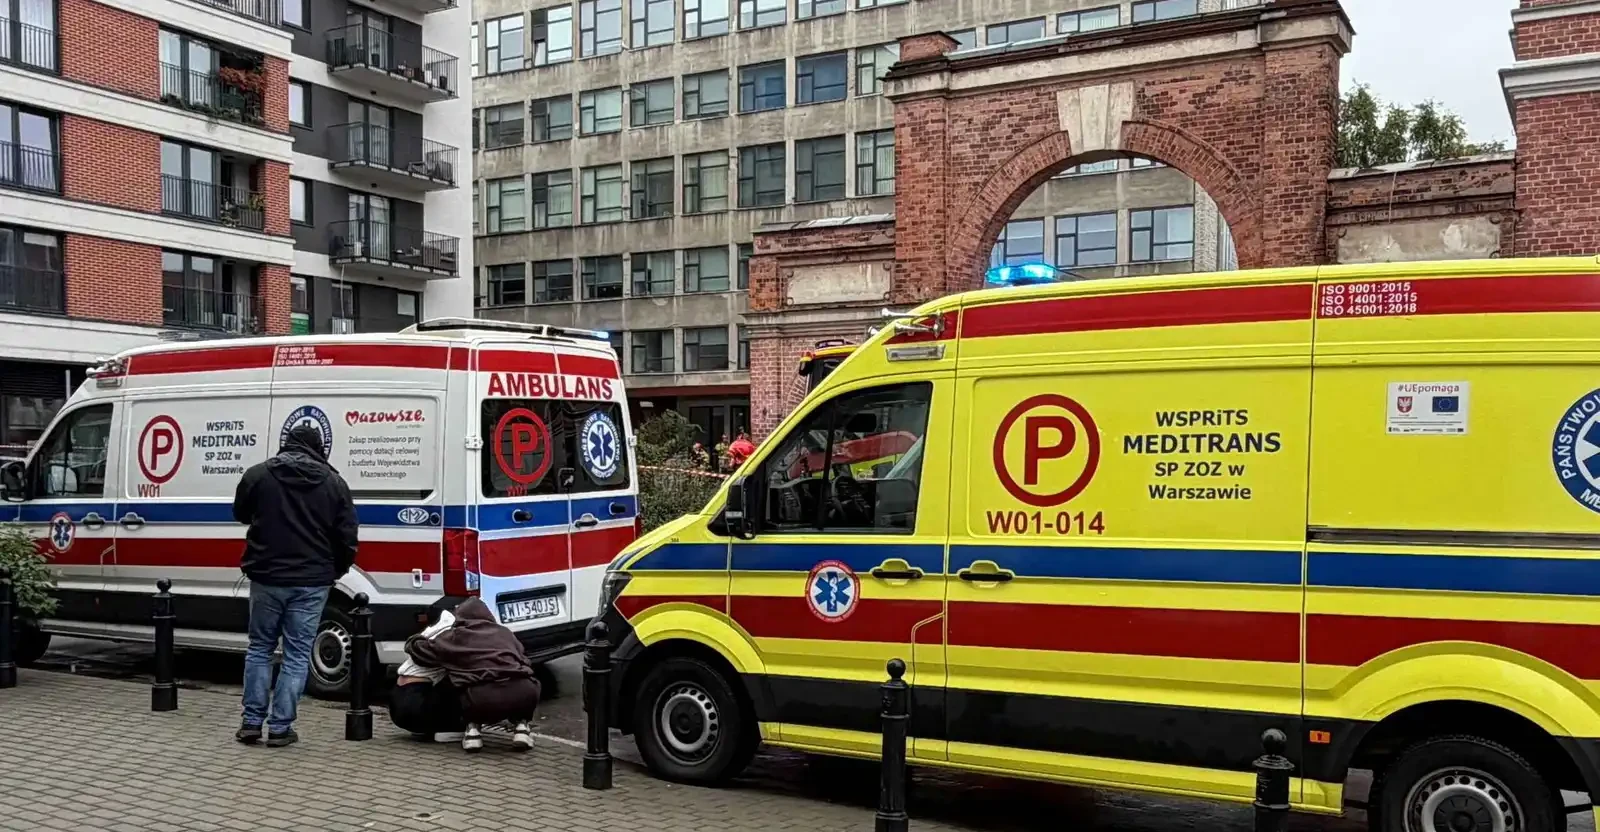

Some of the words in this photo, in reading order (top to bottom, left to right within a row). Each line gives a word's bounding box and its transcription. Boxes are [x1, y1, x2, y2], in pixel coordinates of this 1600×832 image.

[1322, 284, 1345, 295] ISO
[1348, 282, 1411, 294] 9001:2015
[1321, 295, 1345, 306] ISO
[1348, 292, 1418, 305] 14001:2015
[1321, 306, 1344, 316] ISO
[1346, 303, 1417, 315] 45001:2018
[487, 372, 613, 400] AMBULANS
[1397, 383, 1460, 395] #UEpomaga
[1155, 409, 1249, 427] WSPRiTS
[206, 420, 245, 432] WSPRiTS
[192, 434, 257, 448] MEDITRANS
[511, 422, 538, 469] P
[1123, 432, 1281, 454] MEDITRANS
[151, 428, 174, 470] P
[204, 451, 216, 461] SP
[216, 451, 233, 461] ZOZ
[234, 453, 242, 461] w
[1023, 415, 1077, 485] P
[201, 464, 244, 474] Warszawie
[1154, 462, 1179, 477] SP
[1184, 461, 1222, 477] ZOZ
[1228, 464, 1245, 477] w
[137, 483, 161, 498] W01
[1148, 484, 1252, 500] Warszawie
[986, 511, 1105, 535] W01-014
